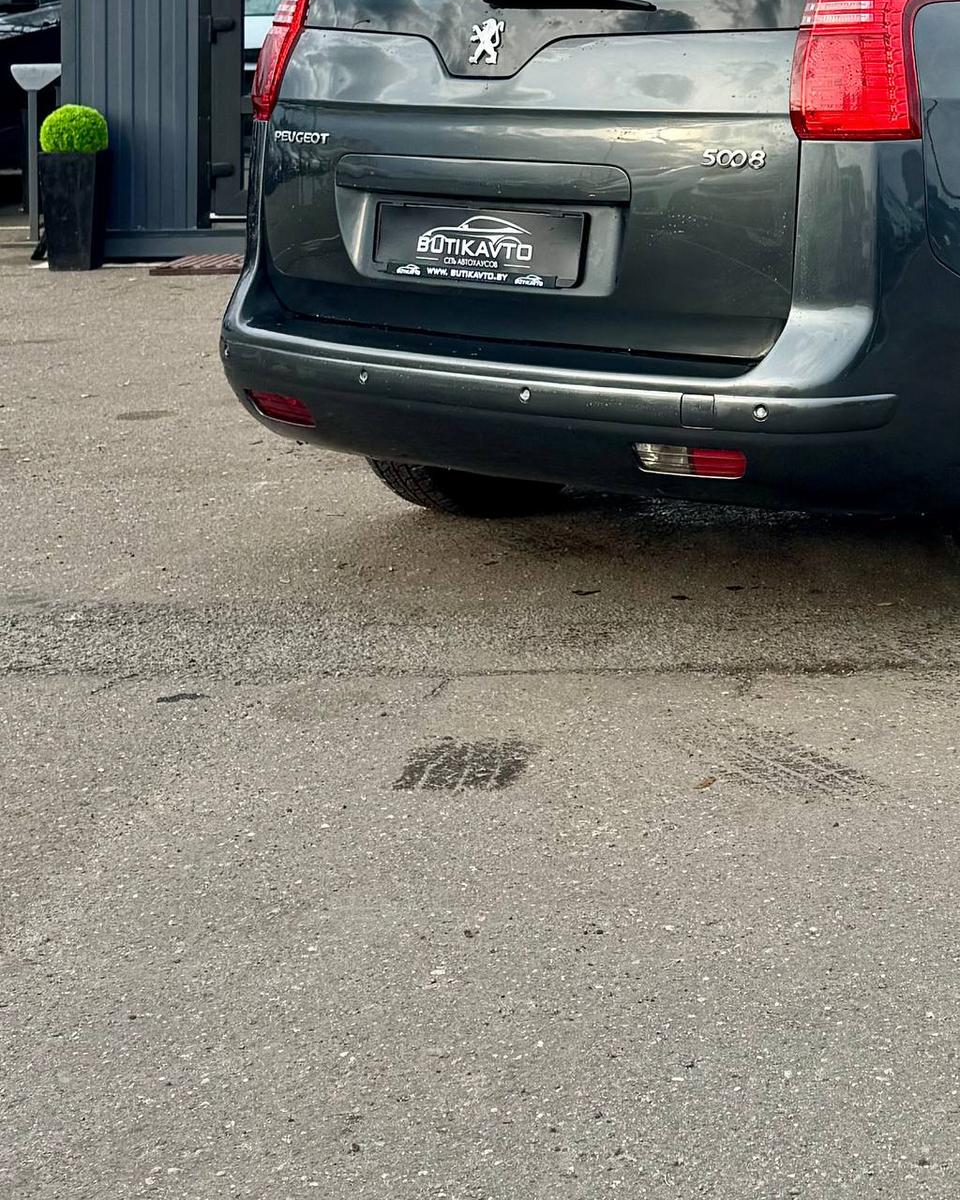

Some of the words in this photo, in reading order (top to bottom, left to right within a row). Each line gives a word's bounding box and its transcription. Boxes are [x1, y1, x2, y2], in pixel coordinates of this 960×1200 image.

[274, 130, 330, 144] PEUGEOT
[701, 148, 767, 170] 5008
[416, 234, 534, 261] BUTIKAVTO
[457, 258, 498, 269] АВТОХАУСОВ
[426, 267, 448, 277] WWW.
[450, 269, 509, 281] BUTIKAVTO.BY
